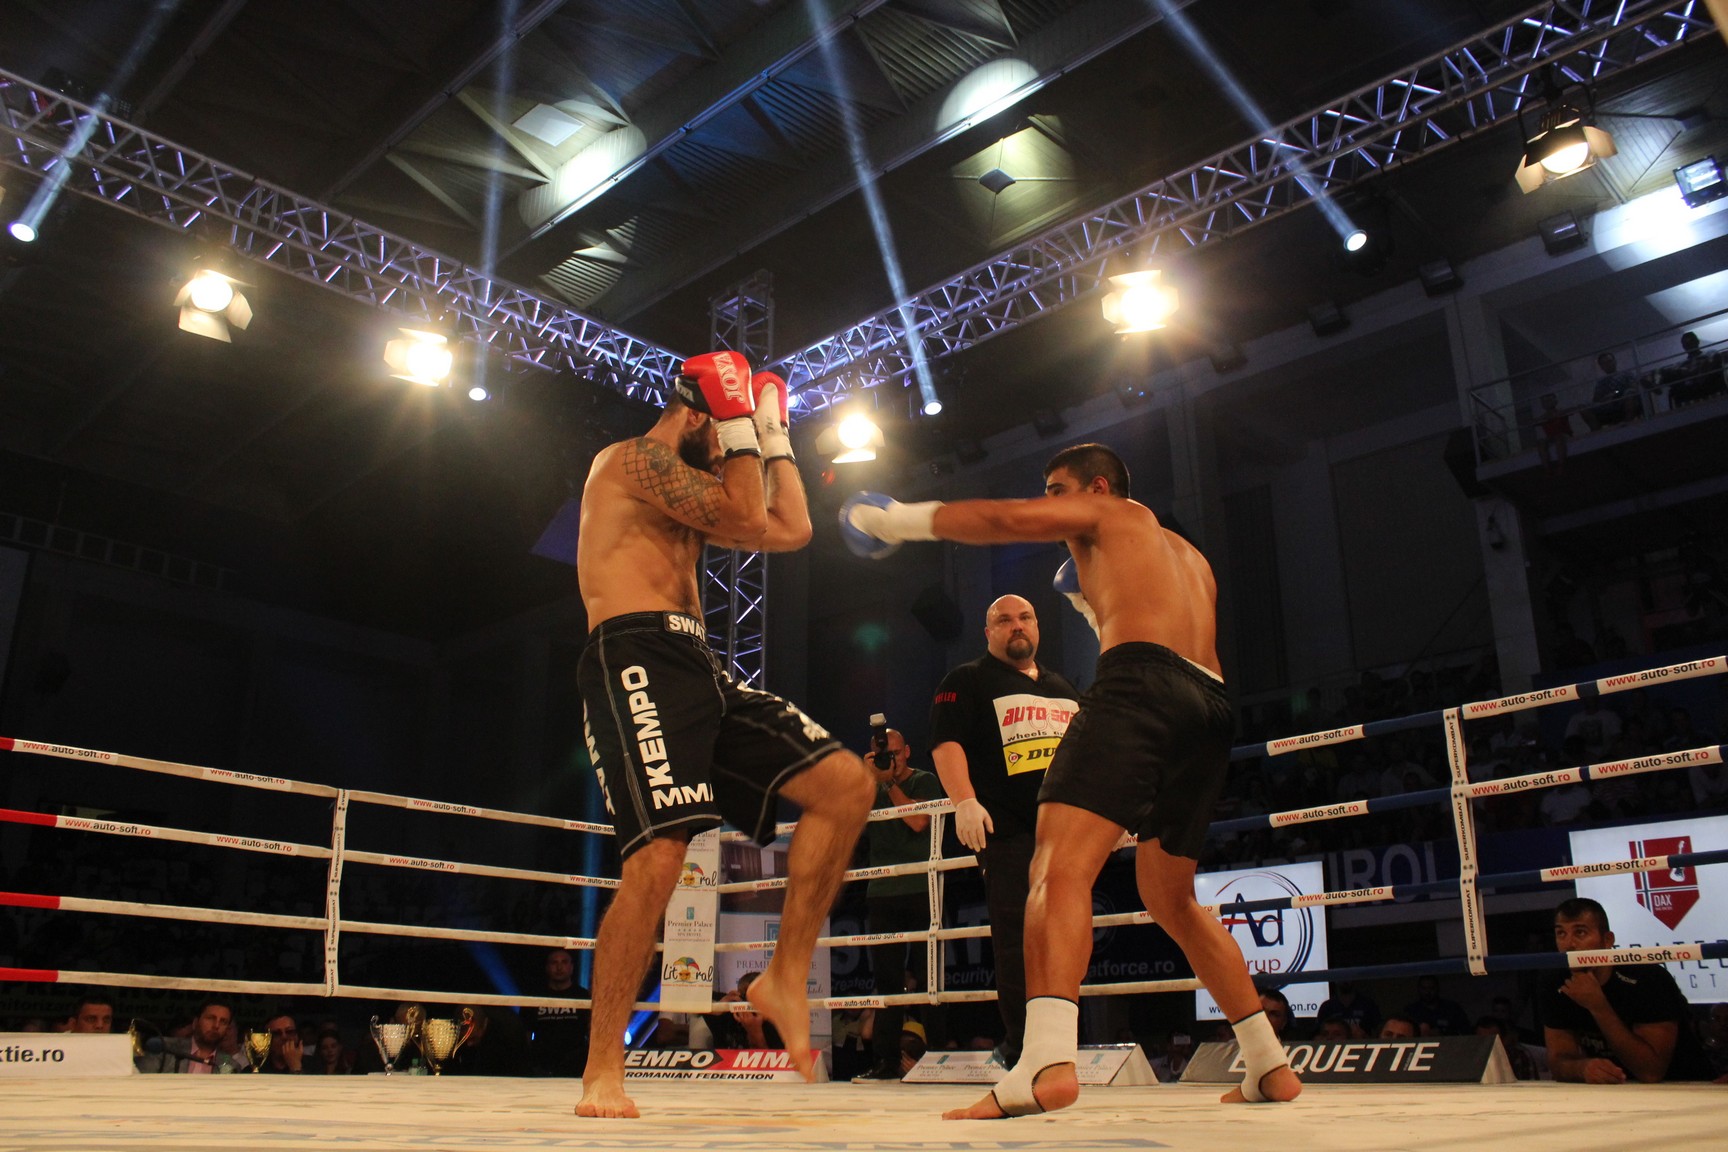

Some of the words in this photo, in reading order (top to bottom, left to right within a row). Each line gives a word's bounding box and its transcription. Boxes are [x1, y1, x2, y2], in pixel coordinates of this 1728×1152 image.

[712, 351, 746, 404] JOYA
[669, 614, 706, 642] SWAT
[1606, 658, 1717, 688] www.auto-soft.ro
[1470, 686, 1567, 714] www.auto-soft.ro
[620, 665, 674, 788] KEMPO
[1007, 730, 1047, 742] wheels
[1273, 726, 1355, 749] www.auto-soft.ro
[22, 741, 111, 760] www.auto-soft.ro
[1027, 747, 1057, 761] DU
[1448, 721, 1463, 778] SUPERKOMBAT
[1598, 750, 1709, 774] www.auto-soft.ro
[210, 768, 286, 786] www.auto-soft.ro
[1472, 772, 1571, 795] www.auto-soft.ro
[413, 799, 477, 816] www.auto-soft.ro
[896, 799, 951, 815] www.auto-soft.ro
[1276, 803, 1360, 823] www.auto-soft.ro
[64, 818, 152, 836] www.auto-soft.ro
[1457, 801, 1470, 860] SUPERKOMBAT
[216, 835, 293, 853] www.auto-soft.ro
[389, 856, 455, 871] www.auto-soft.ro
[1549, 858, 1657, 877] www.auto-soft.ro
[1298, 885, 1384, 902] www.auto-soft.ro
[1466, 888, 1478, 951] SUPERKOMBAT
[851, 933, 904, 942] www.auto-soft.ro
[1577, 950, 1691, 965] www.auto-soft.ro
[828, 999, 880, 1008] www.auto-soft.ro
[624, 1050, 715, 1069] EMPO
[732, 1051, 799, 1069] MM
[625, 1071, 692, 1080] ROMANIAN
[696, 1072, 775, 1081] FEDERATION
